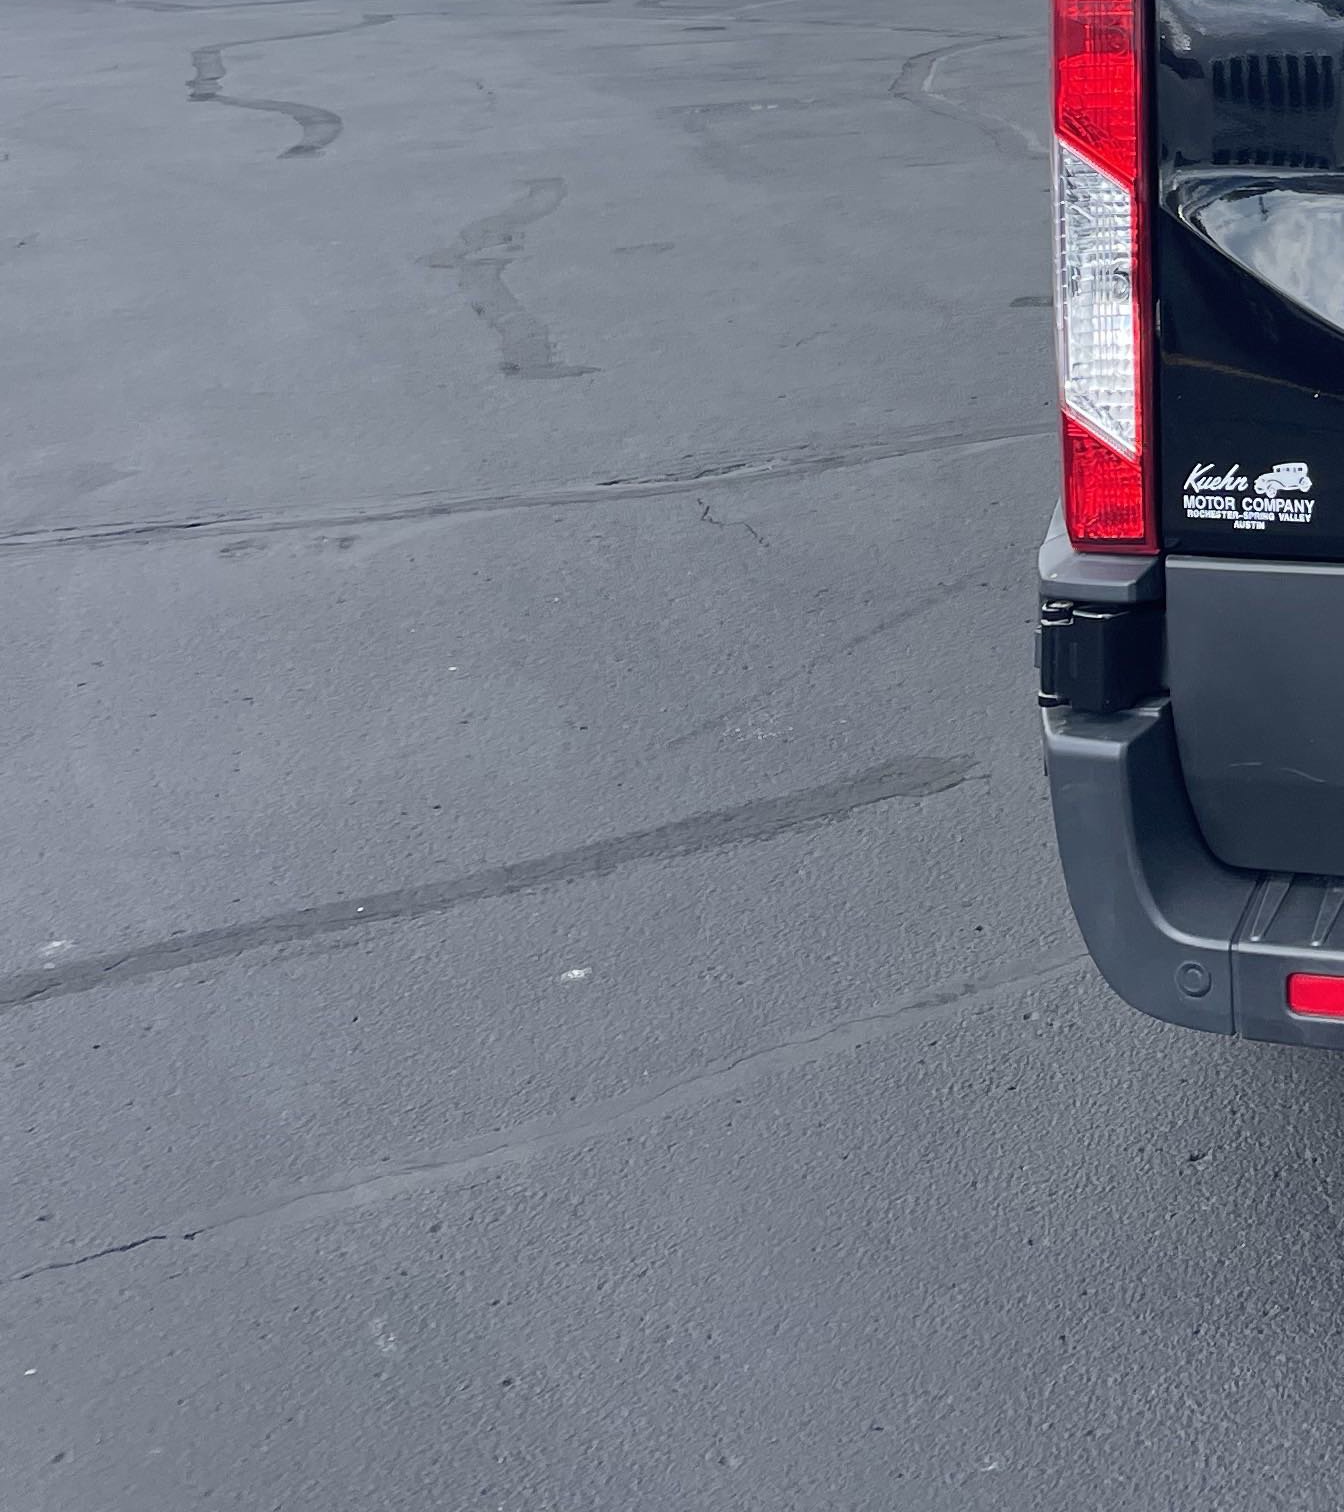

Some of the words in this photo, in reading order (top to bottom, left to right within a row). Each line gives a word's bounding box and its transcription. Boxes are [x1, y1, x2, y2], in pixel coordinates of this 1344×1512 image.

[1183, 462, 1249, 494] Kuehn
[1183, 494, 1236, 510] MOTOR
[1241, 497, 1316, 514] COMPANY
[1233, 520, 1266, 530] AUSTIN
[1278, 513, 1312, 523] VALLEY
